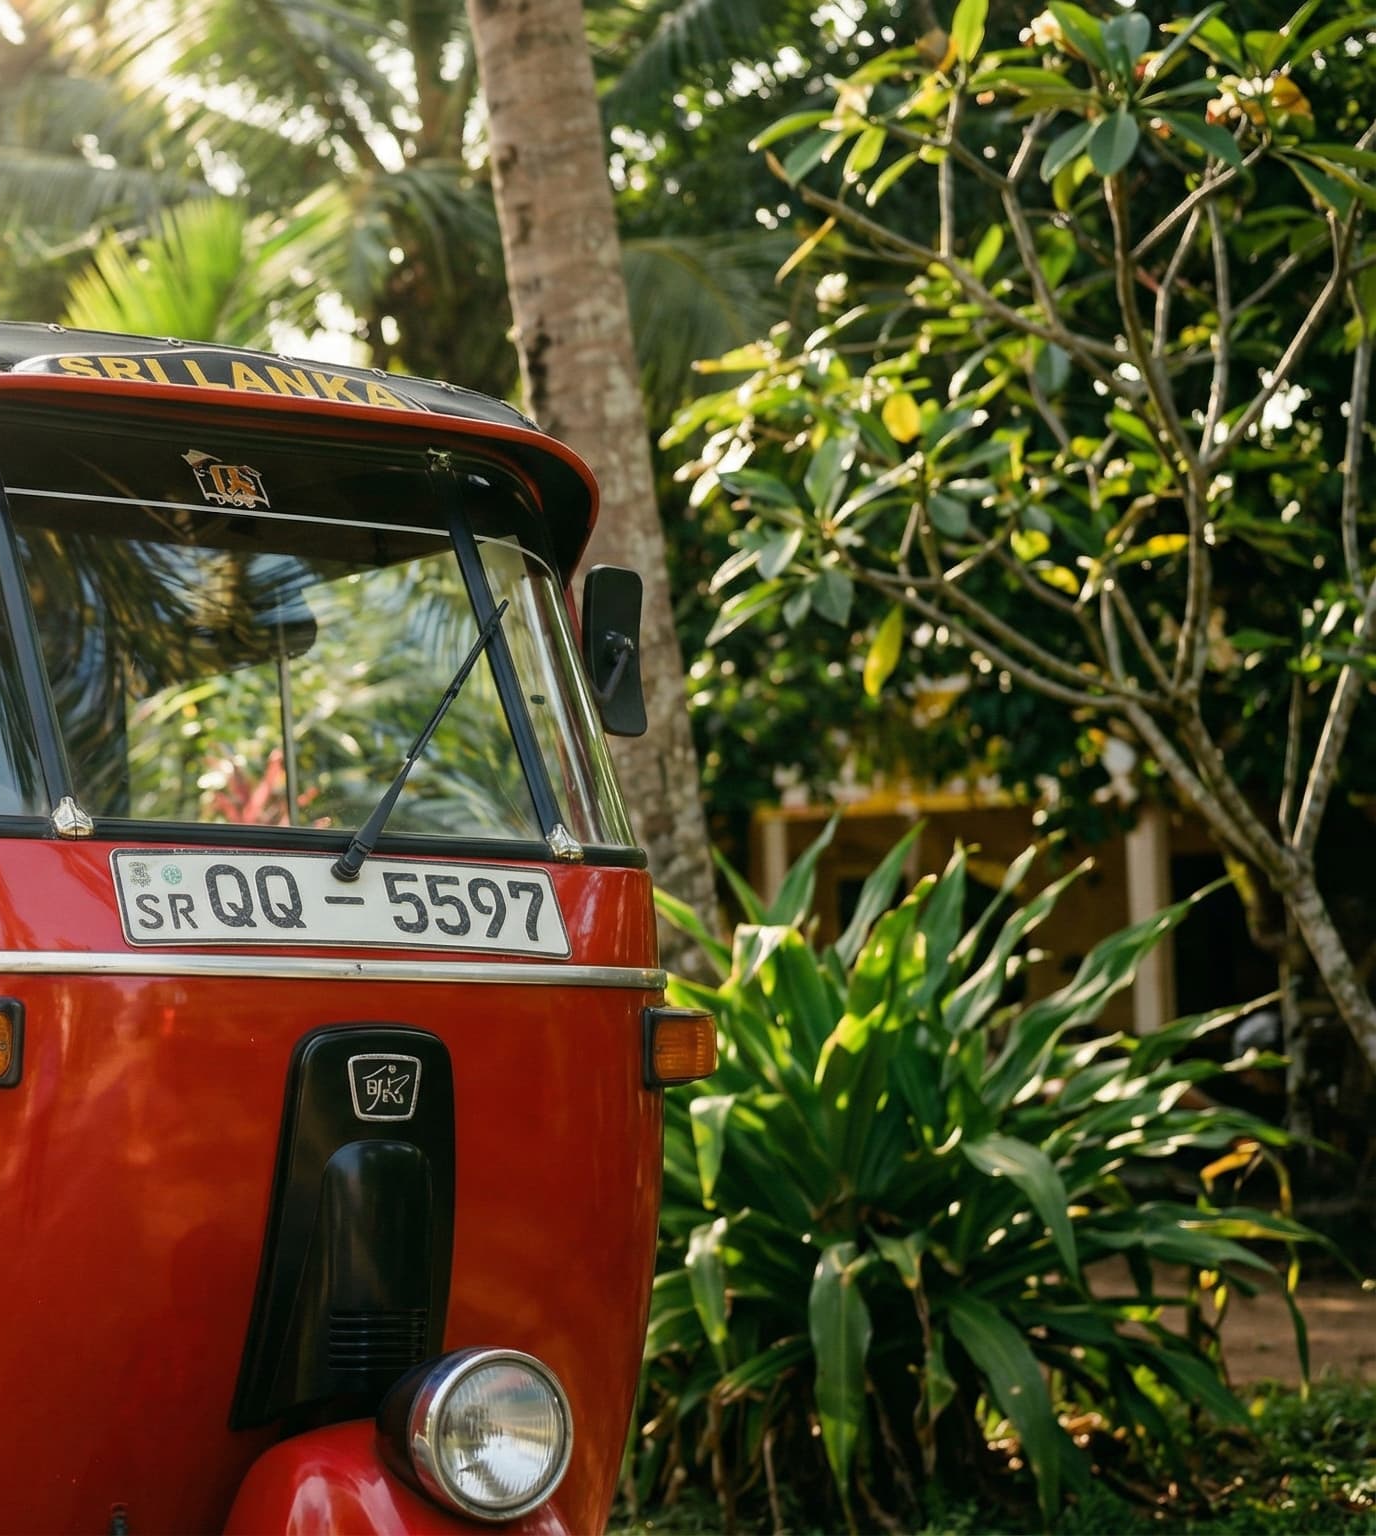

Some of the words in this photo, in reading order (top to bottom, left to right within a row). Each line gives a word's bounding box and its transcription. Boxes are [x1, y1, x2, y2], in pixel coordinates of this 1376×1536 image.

[57, 356, 171, 384] SRI
[182, 359, 408, 411] LANKA
[135, 893, 199, 930] SR
[204, 863, 308, 929] QQ
[381, 871, 545, 942] 5597
